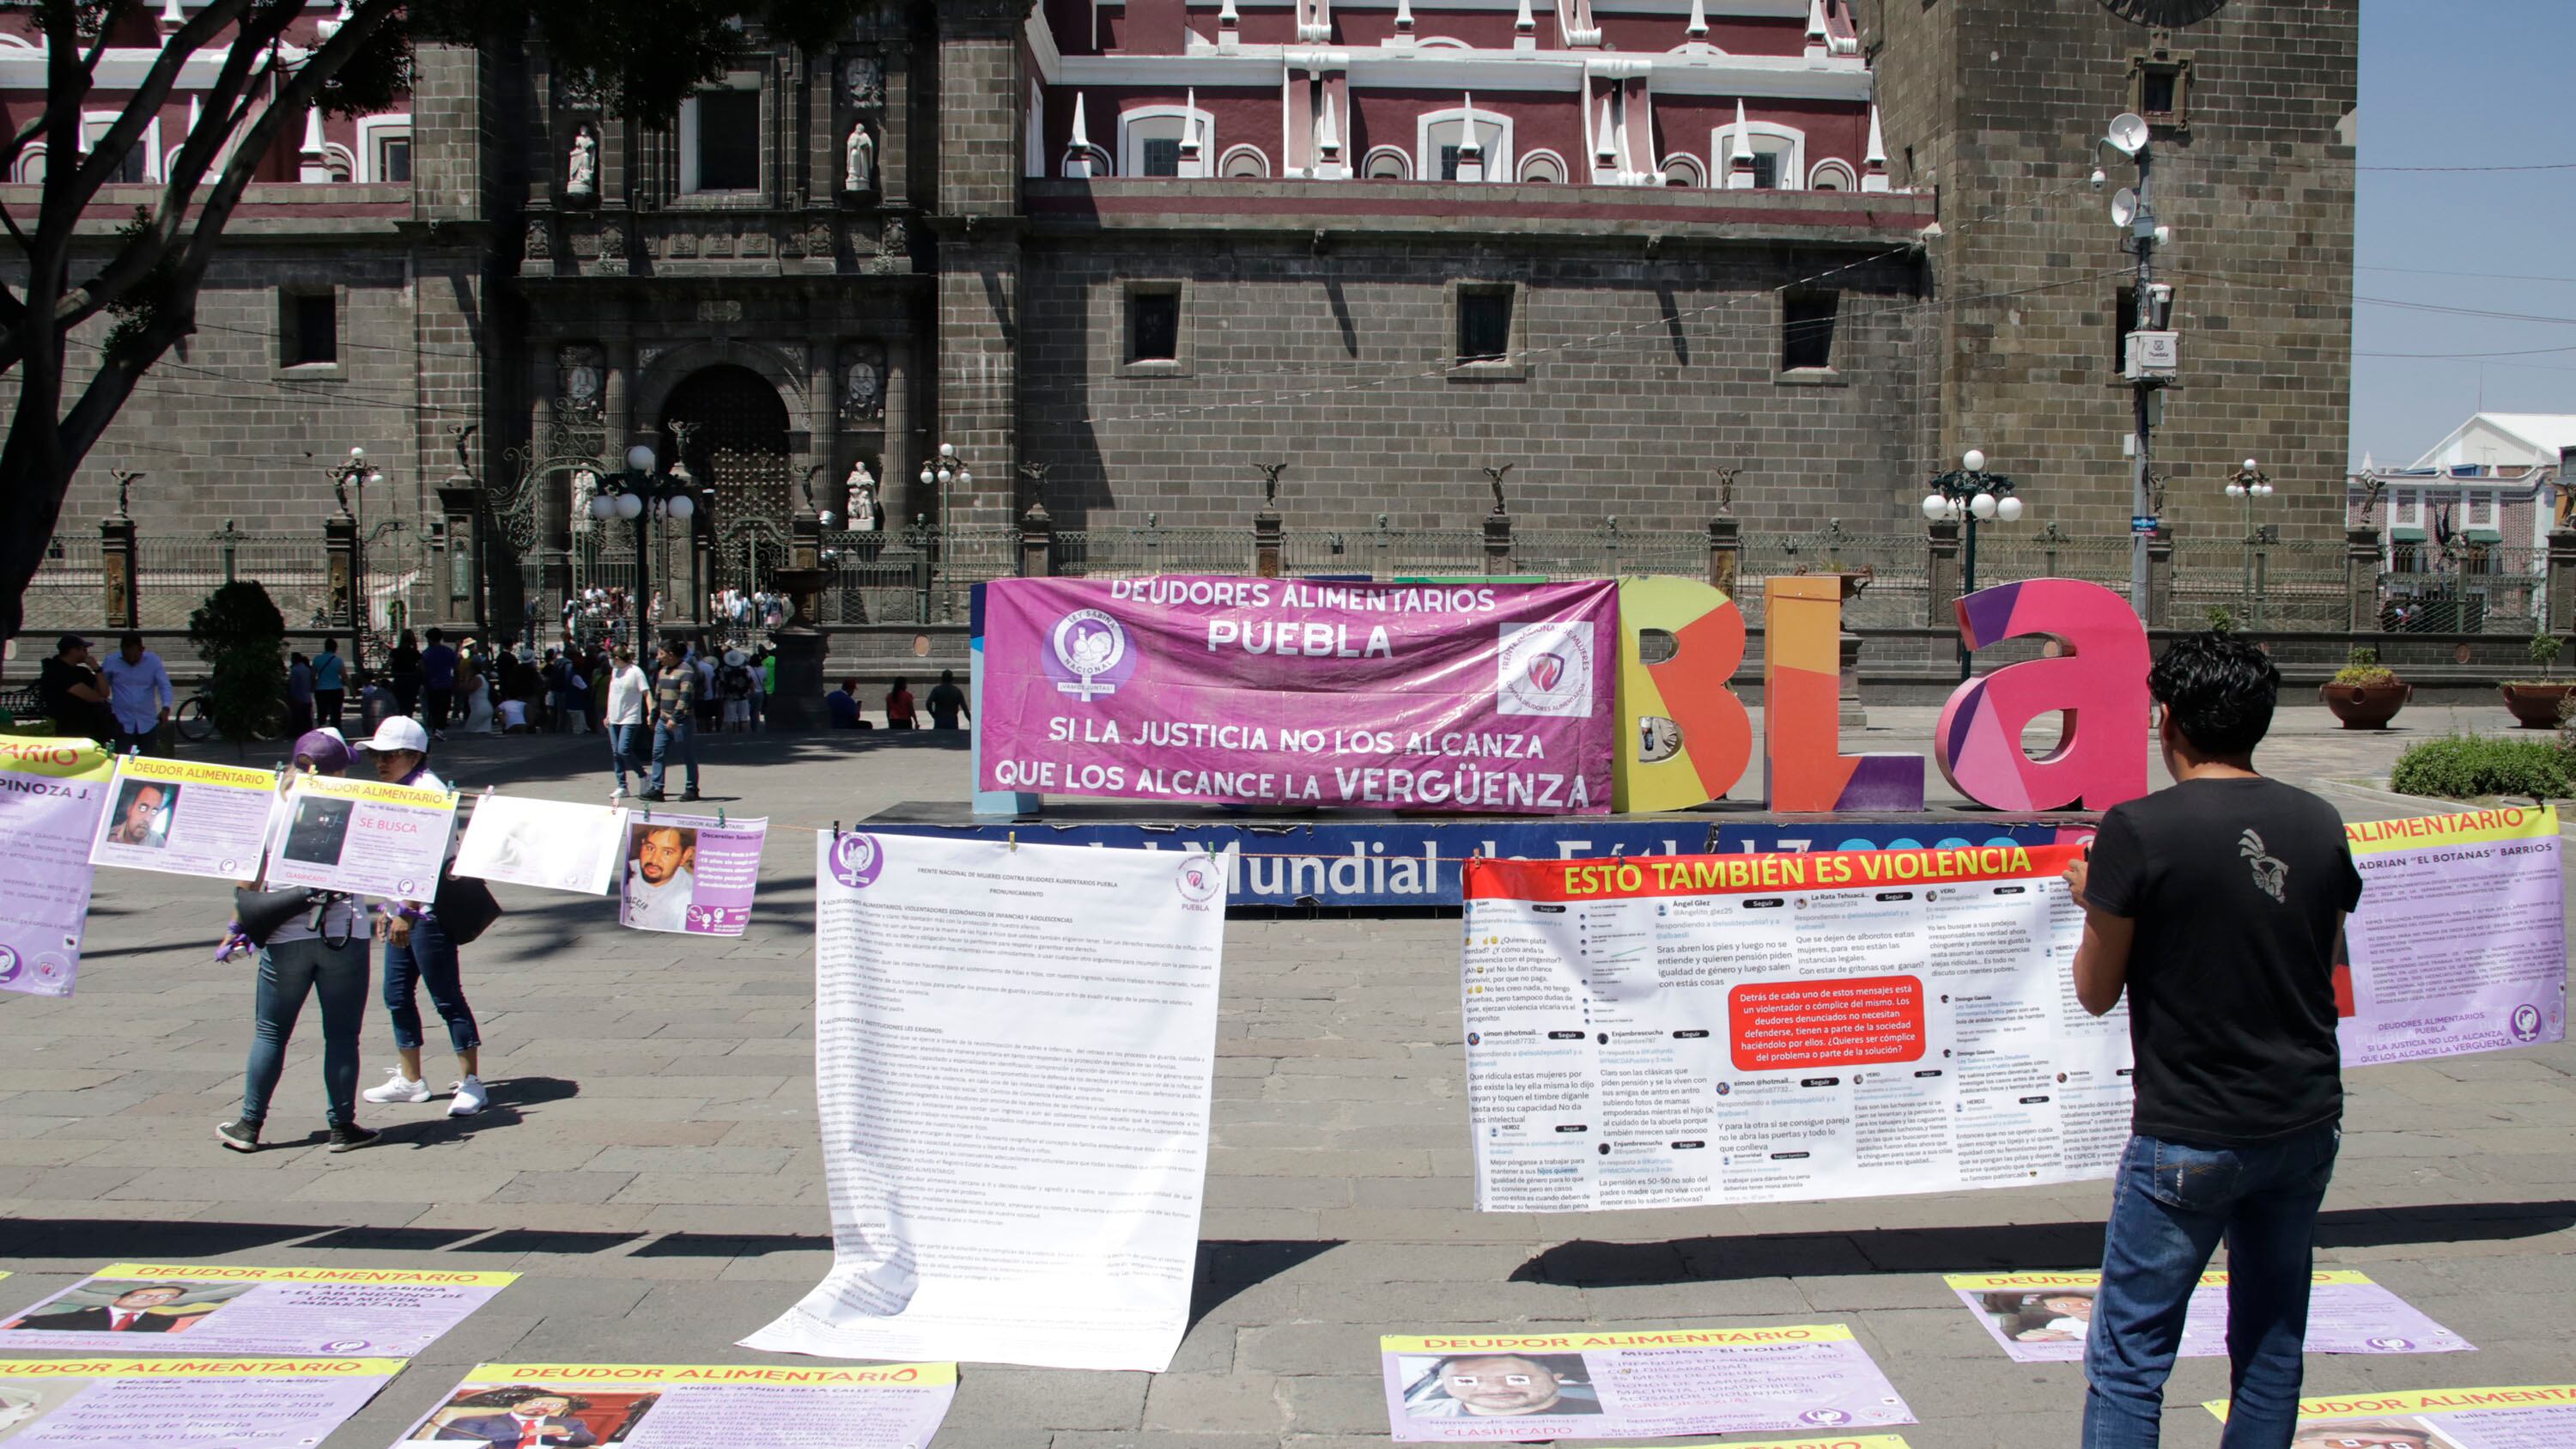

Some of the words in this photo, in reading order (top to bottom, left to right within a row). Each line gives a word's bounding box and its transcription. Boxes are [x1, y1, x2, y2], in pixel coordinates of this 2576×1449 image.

[1111, 580, 1270, 608] DEUDORES
[1281, 583, 1496, 613] ALIMENTARIOS
[1067, 612, 1082, 624] LEY
[1086, 611, 1116, 630] SABINA
[1207, 620, 1394, 660] PUEBLA
[1064, 658, 1113, 673] NACIONAL
[1048, 716, 1075, 741] SI
[1084, 718, 1121, 744] LA
[1133, 721, 1268, 752] JUSTICIA
[1279, 728, 1323, 752] NO
[1335, 730, 1394, 755] LOS
[1404, 731, 1546, 759] ALCANZA
[134, 763, 183, 778] DEUDOR
[185, 768, 265, 785] ALIMENTARIO
[311, 779, 360, 795] DEUDOR
[362, 785, 442, 804] ALIMENTARIO
[995, 759, 1055, 788] QUE
[1065, 763, 1125, 791] LOS
[1135, 767, 1275, 799] ALCANCE
[1285, 774, 1322, 800] LA
[1334, 764, 1590, 808] VERGÜENZA
[78, 788, 91, 800] J.
[358, 817, 376, 829] SE
[379, 819, 417, 833] BUSCA
[704, 821, 745, 830] ALIMNTARIO
[2343, 807, 2524, 843] ALIMENTARIO
[2358, 857, 2407, 871] ADRIAN
[2500, 843, 2553, 856] BARRIOS
[285, 872, 328, 882] CLASIFICADO
[1564, 864, 1643, 895] ESTO
[1651, 854, 1805, 891] TAMBIÉN
[1814, 855, 1853, 883] ES
[1858, 846, 2032, 880] VIOLENCIA
[1182, 903, 1210, 912] PUEBLA
[1716, 943, 1734, 952] pies
[1742, 942, 1764, 951] luego
[1657, 956, 1694, 965] entiende
[1701, 955, 1734, 964] quieren
[1735, 953, 1768, 962] pensión
[1769, 952, 1792, 960] piden
[1658, 968, 1693, 977] igualdad
[1707, 967, 1736, 976] género
[1737, 966, 1742, 975] y
[1744, 965, 1767, 973] luego
[1740, 993, 1767, 1002] Detrás
[1768, 992, 1779, 1001] de
[1780, 991, 1801, 1000] cada
[1856, 987, 1893, 995] mensajes
[1755, 1004, 1803, 1013] violentador
[1812, 1002, 1849, 1010] cómplice
[1795, 1014, 1847, 1022] denunciados
[2378, 1020, 2422, 1030] DEUDORES
[2424, 1013, 2485, 1025] ALIMENTARIOS
[1744, 1029, 1793, 1038] defenderse,
[1875, 1021, 1911, 1030] sociedad
[1741, 1041, 1787, 1050] haciéndolo
[1827, 1037, 1864, 1045] ¿Quieres
[1880, 1033, 1916, 1042] cómplice
[2391, 1039, 2427, 1049] JUSTICIA
[2462, 1031, 2503, 1040] ALCANZA
[1771, 1052, 1811, 1061] problema
[1820, 1050, 1842, 1058] parte
[1843, 1048, 1854, 1056] de
[1864, 1044, 1903, 1055] solución?
[2379, 1052, 2397, 1061] LOS
[2398, 1048, 2439, 1057] ALCANCE
[136, 1267, 267, 1277] DEUDOR
[274, 1270, 479, 1282] ALIMENTARIO
[1984, 1276, 2103, 1285] DEUDO
[1425, 1337, 1571, 1349] DEUDOR
[1582, 1330, 1811, 1345] ALIMENTARIO
[118, 1363, 361, 1372] ALIMENTARIO
[512, 1367, 665, 1379] DEUDOR
[673, 1367, 918, 1381] ALIMENTARIO
[2296, 1398, 2409, 1415] UDOR
[1443, 1426, 1572, 1436] CLASIFICADO
